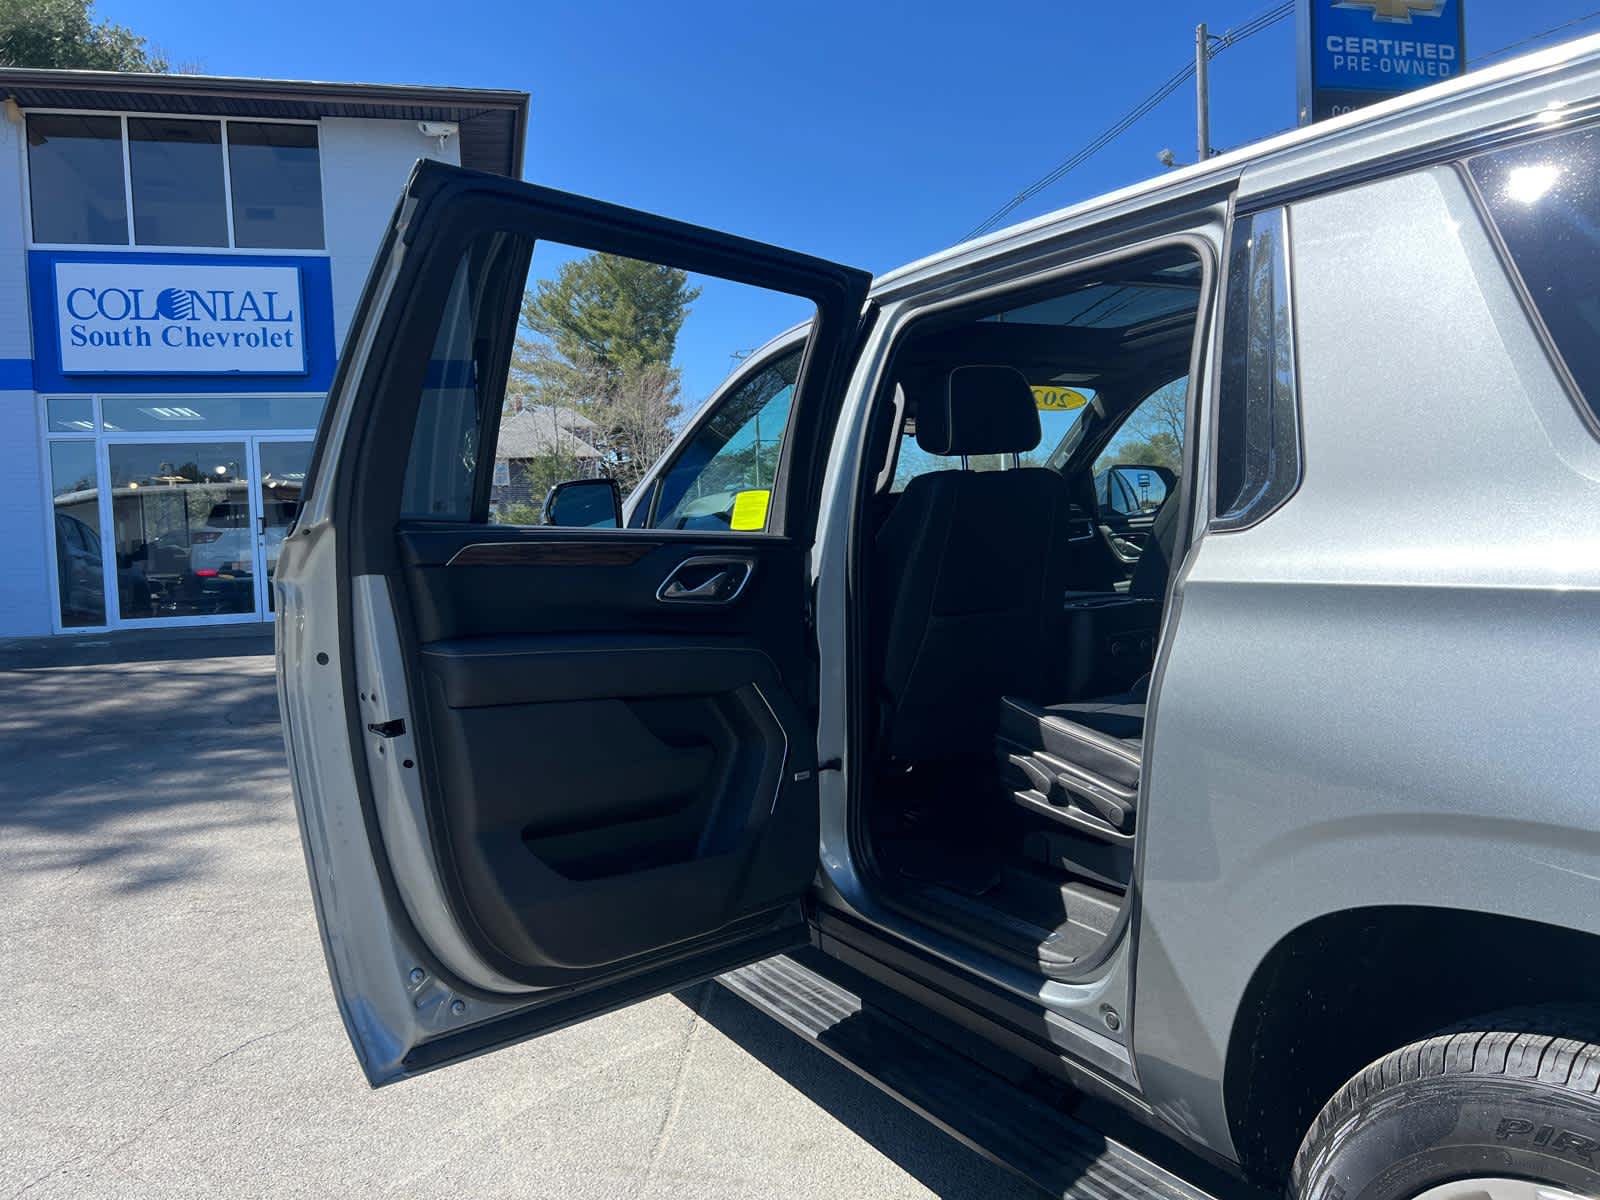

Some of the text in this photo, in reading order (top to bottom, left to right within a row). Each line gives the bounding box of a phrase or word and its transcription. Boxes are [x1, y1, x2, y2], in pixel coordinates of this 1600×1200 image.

[1327, 35, 1456, 60] CERTIFIED
[1333, 55, 1450, 77] PRE-OWNED
[66, 287, 293, 322] COLONIAL
[70, 324, 293, 348] South Chevrolet
